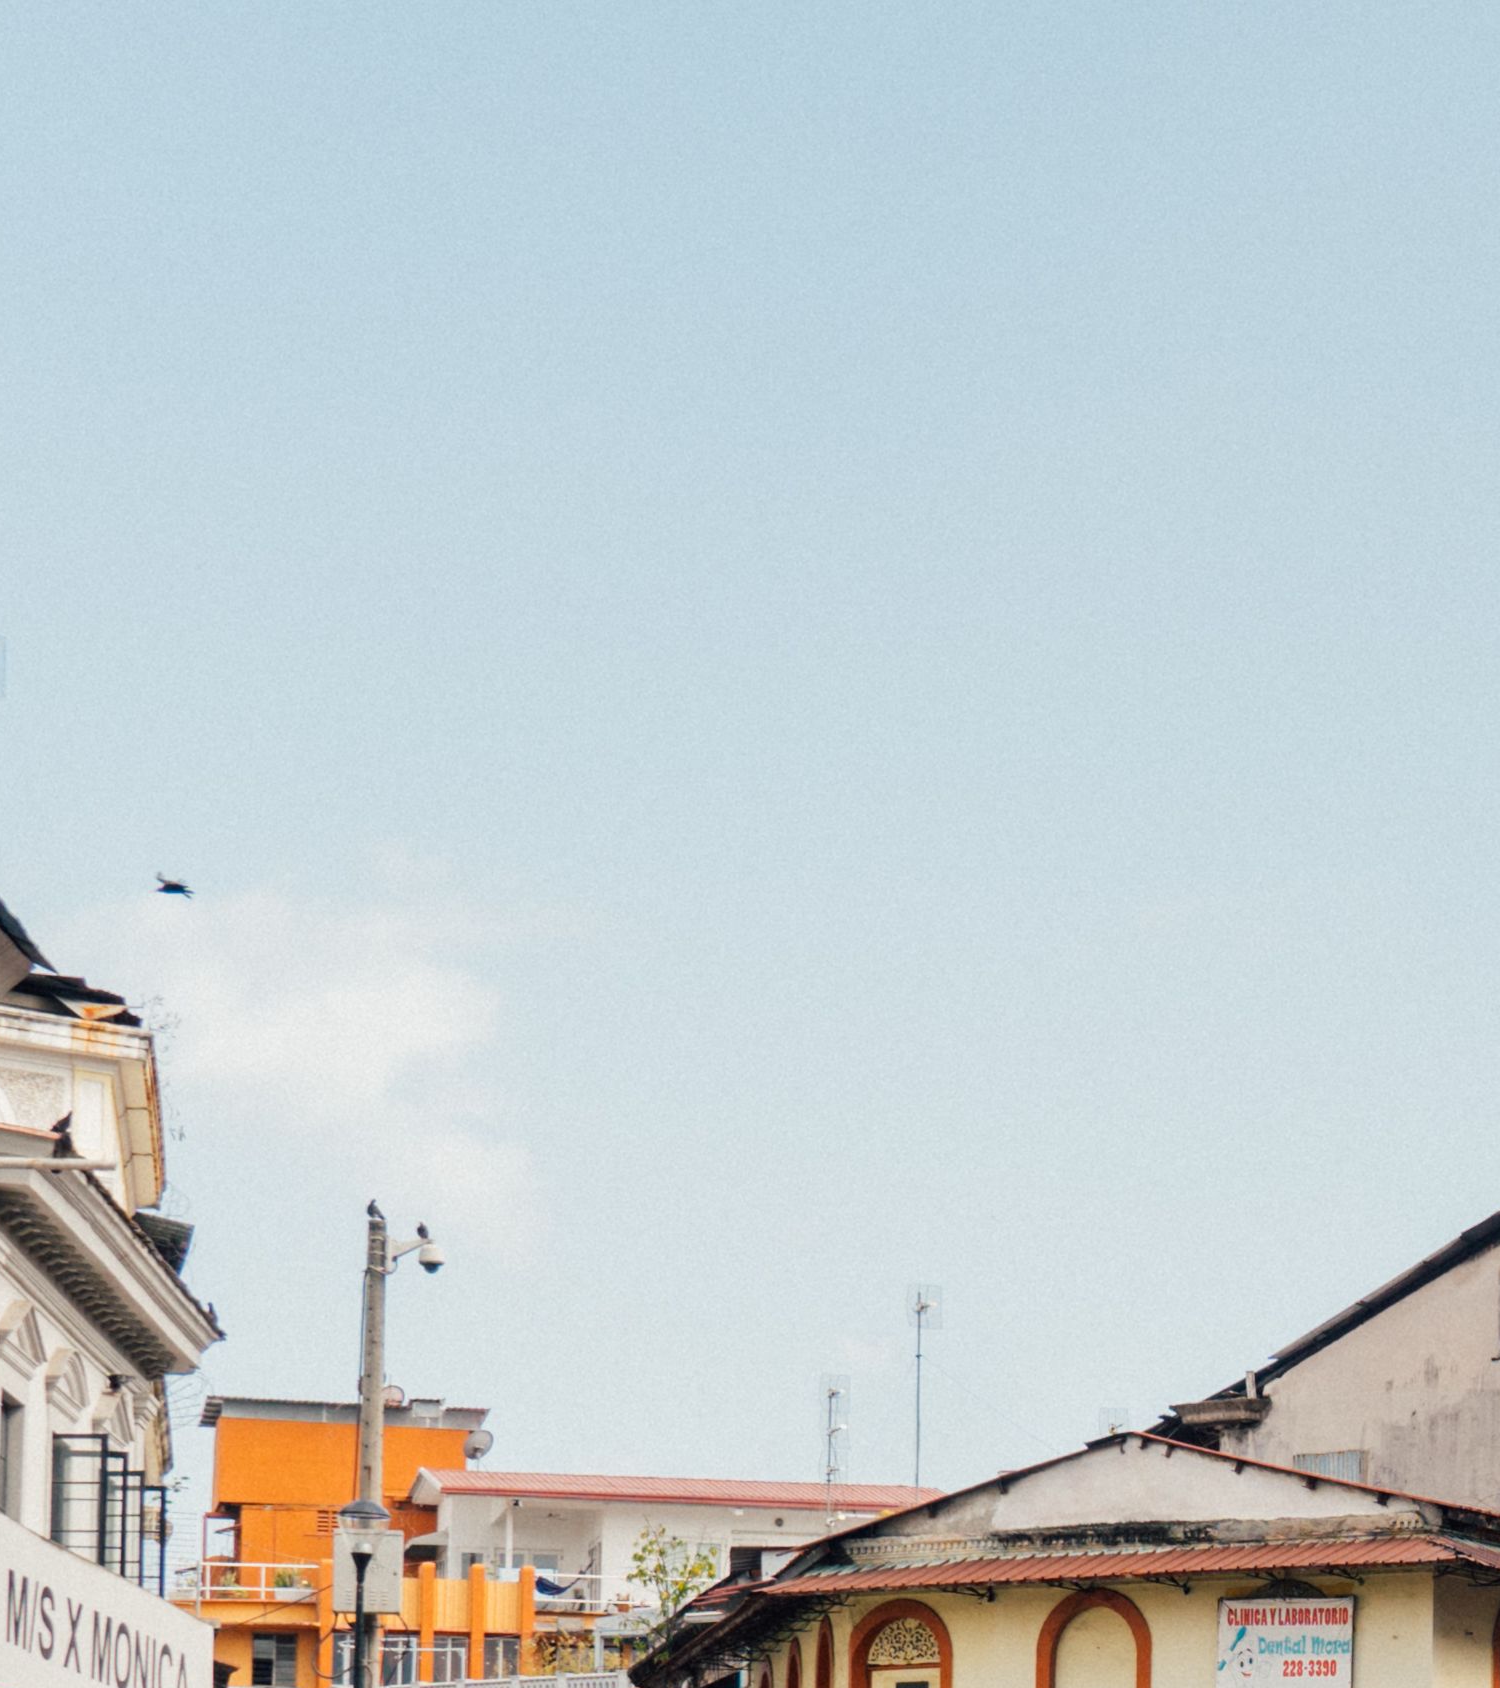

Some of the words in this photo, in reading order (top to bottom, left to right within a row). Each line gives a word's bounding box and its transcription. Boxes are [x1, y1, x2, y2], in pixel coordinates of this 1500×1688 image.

[6, 1569, 56, 1660] M/S
[63, 1597, 83, 1674] X
[1227, 1607, 1267, 1626] CLINICA
[1269, 1608, 1277, 1625] Y
[1278, 1607, 1349, 1626] LABORATORIO
[1258, 1635, 1307, 1655] Dental
[1283, 1659, 1337, 1677] 228-3390
